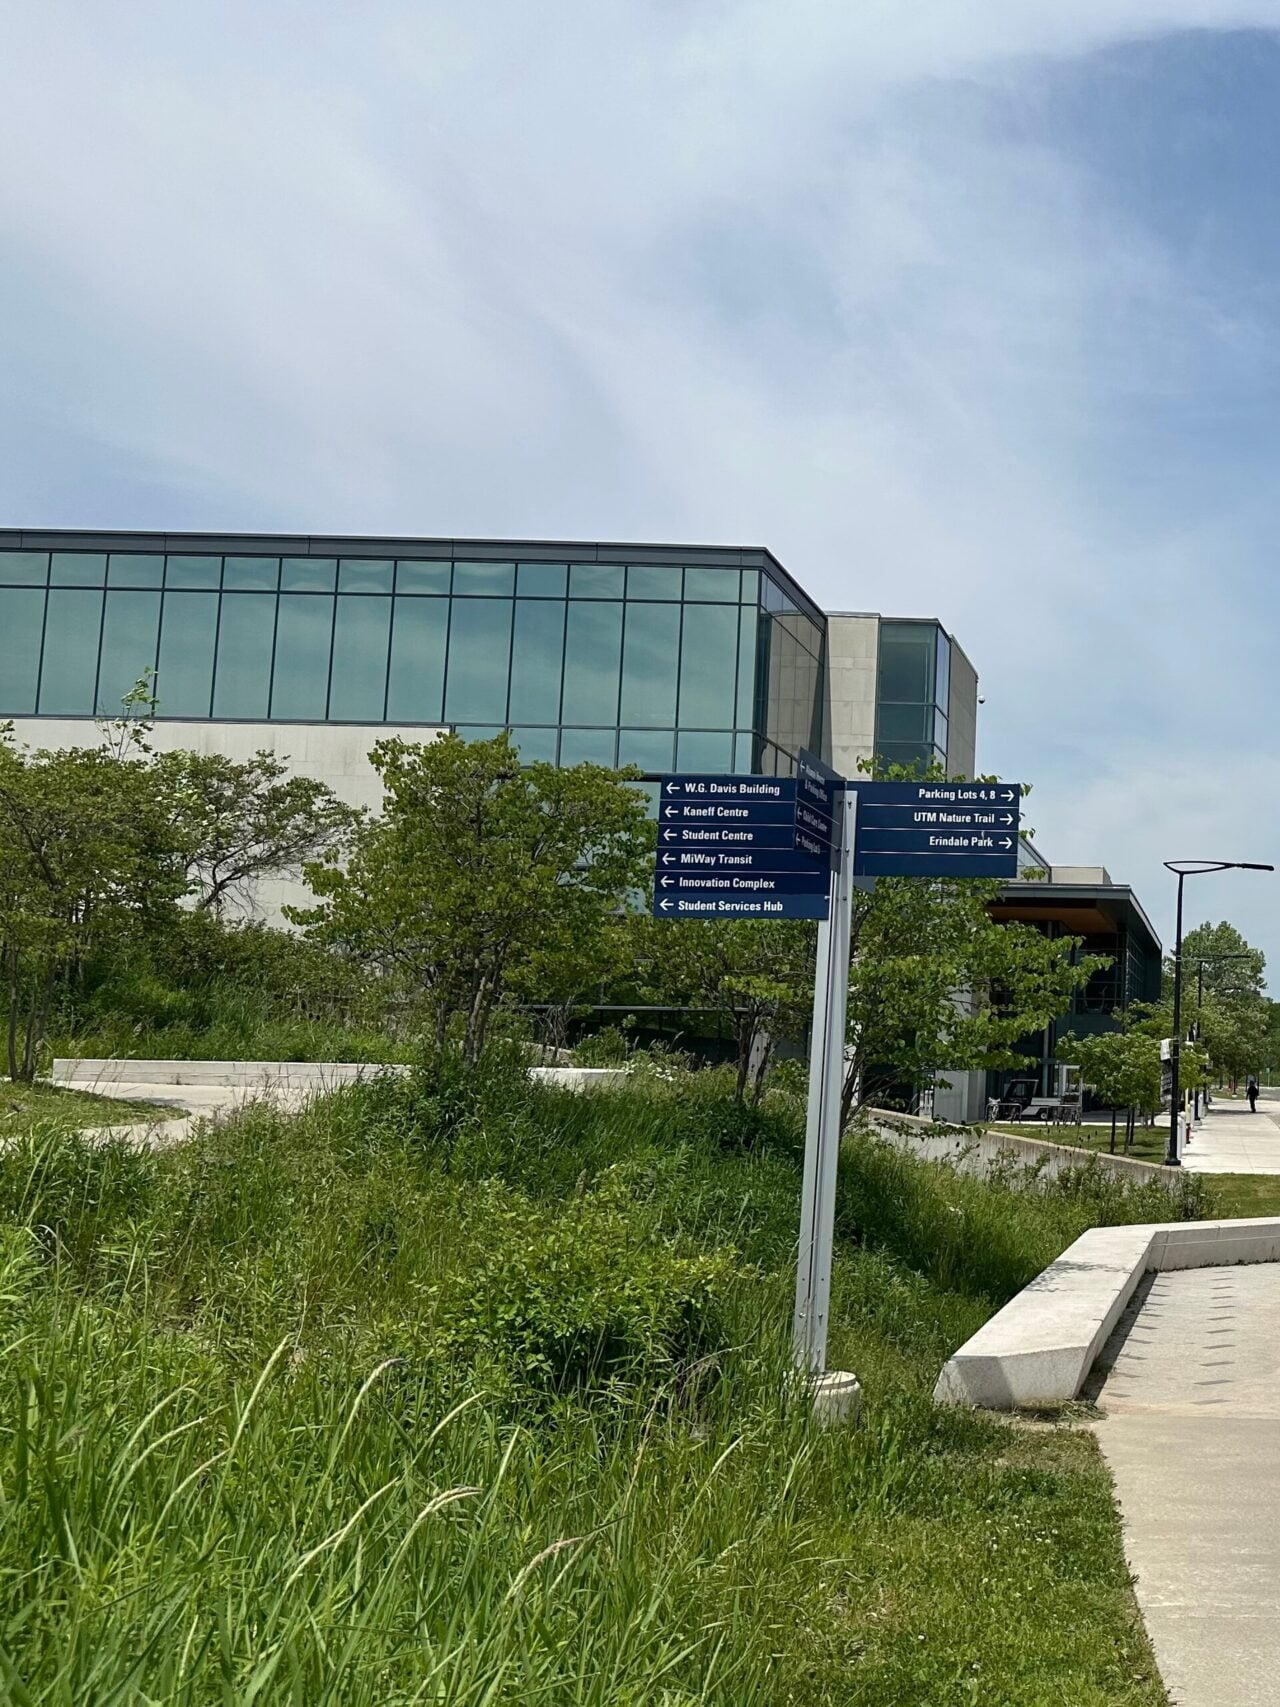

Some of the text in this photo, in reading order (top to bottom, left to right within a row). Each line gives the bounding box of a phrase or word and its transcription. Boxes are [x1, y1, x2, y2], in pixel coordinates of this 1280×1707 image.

[685, 783, 780, 796] W.G. Davis Building
[918, 788, 996, 801] Parking Lots 4, 8
[683, 806, 749, 817] Kaneff Centre
[913, 812, 995, 823] UTM Nature Trail
[682, 830, 754, 841] Student Centre
[929, 836, 994, 847] Erindale Park
[680, 853, 753, 866] MiWay Transit
[679, 877, 775, 891] Innovation Complex
[678, 900, 784, 911] Student Services Hub
